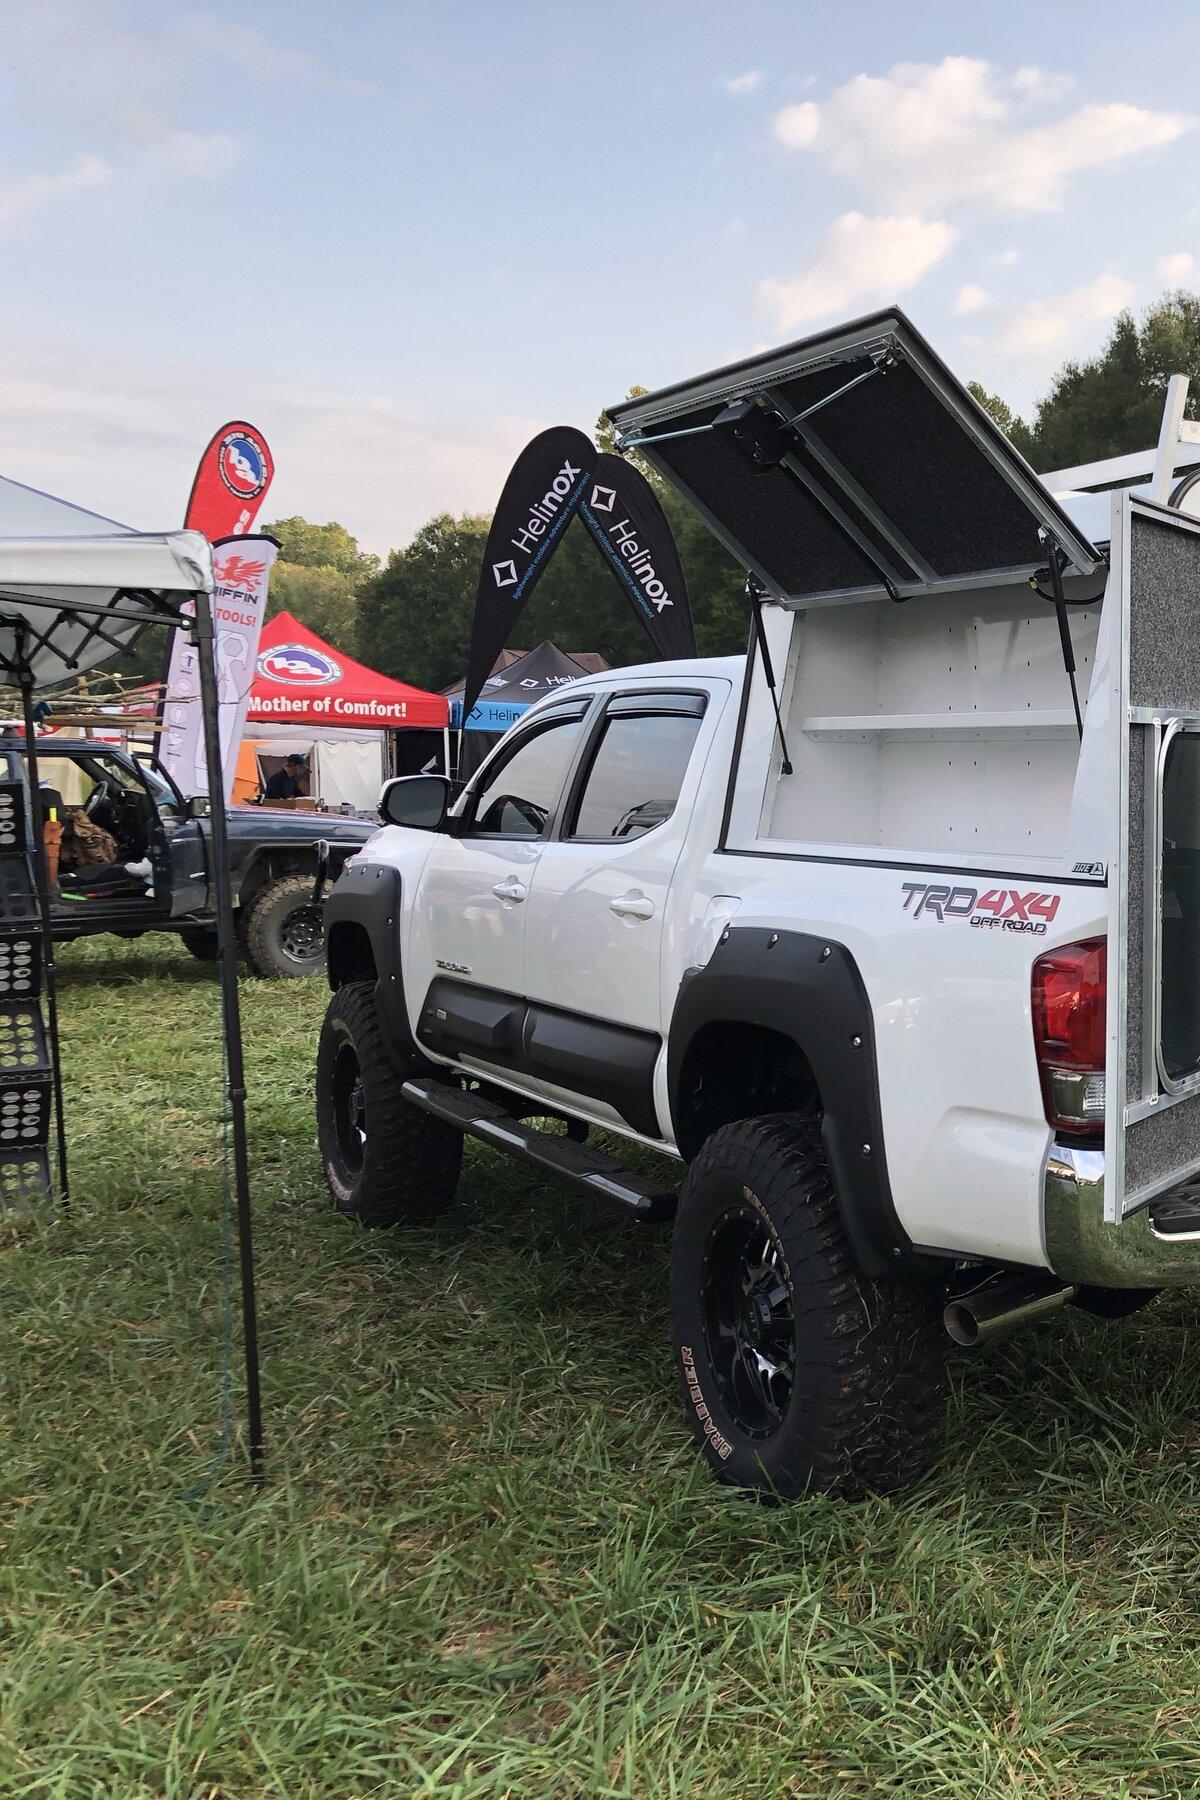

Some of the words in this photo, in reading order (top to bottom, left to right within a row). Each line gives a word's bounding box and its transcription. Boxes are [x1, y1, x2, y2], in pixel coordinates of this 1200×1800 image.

[510, 459, 582, 555] Helinox
[607, 518, 675, 614] Helinox
[215, 607, 257, 627] TOOLS!
[545, 675, 576, 686] Heli
[247, 696, 310, 713] Mother
[313, 696, 332, 713] of
[334, 697, 408, 718] Comfort!
[969, 915, 1001, 929] OFF
[1001, 919, 1048, 936] ROAD
[681, 1346, 733, 1460] GRABBER
